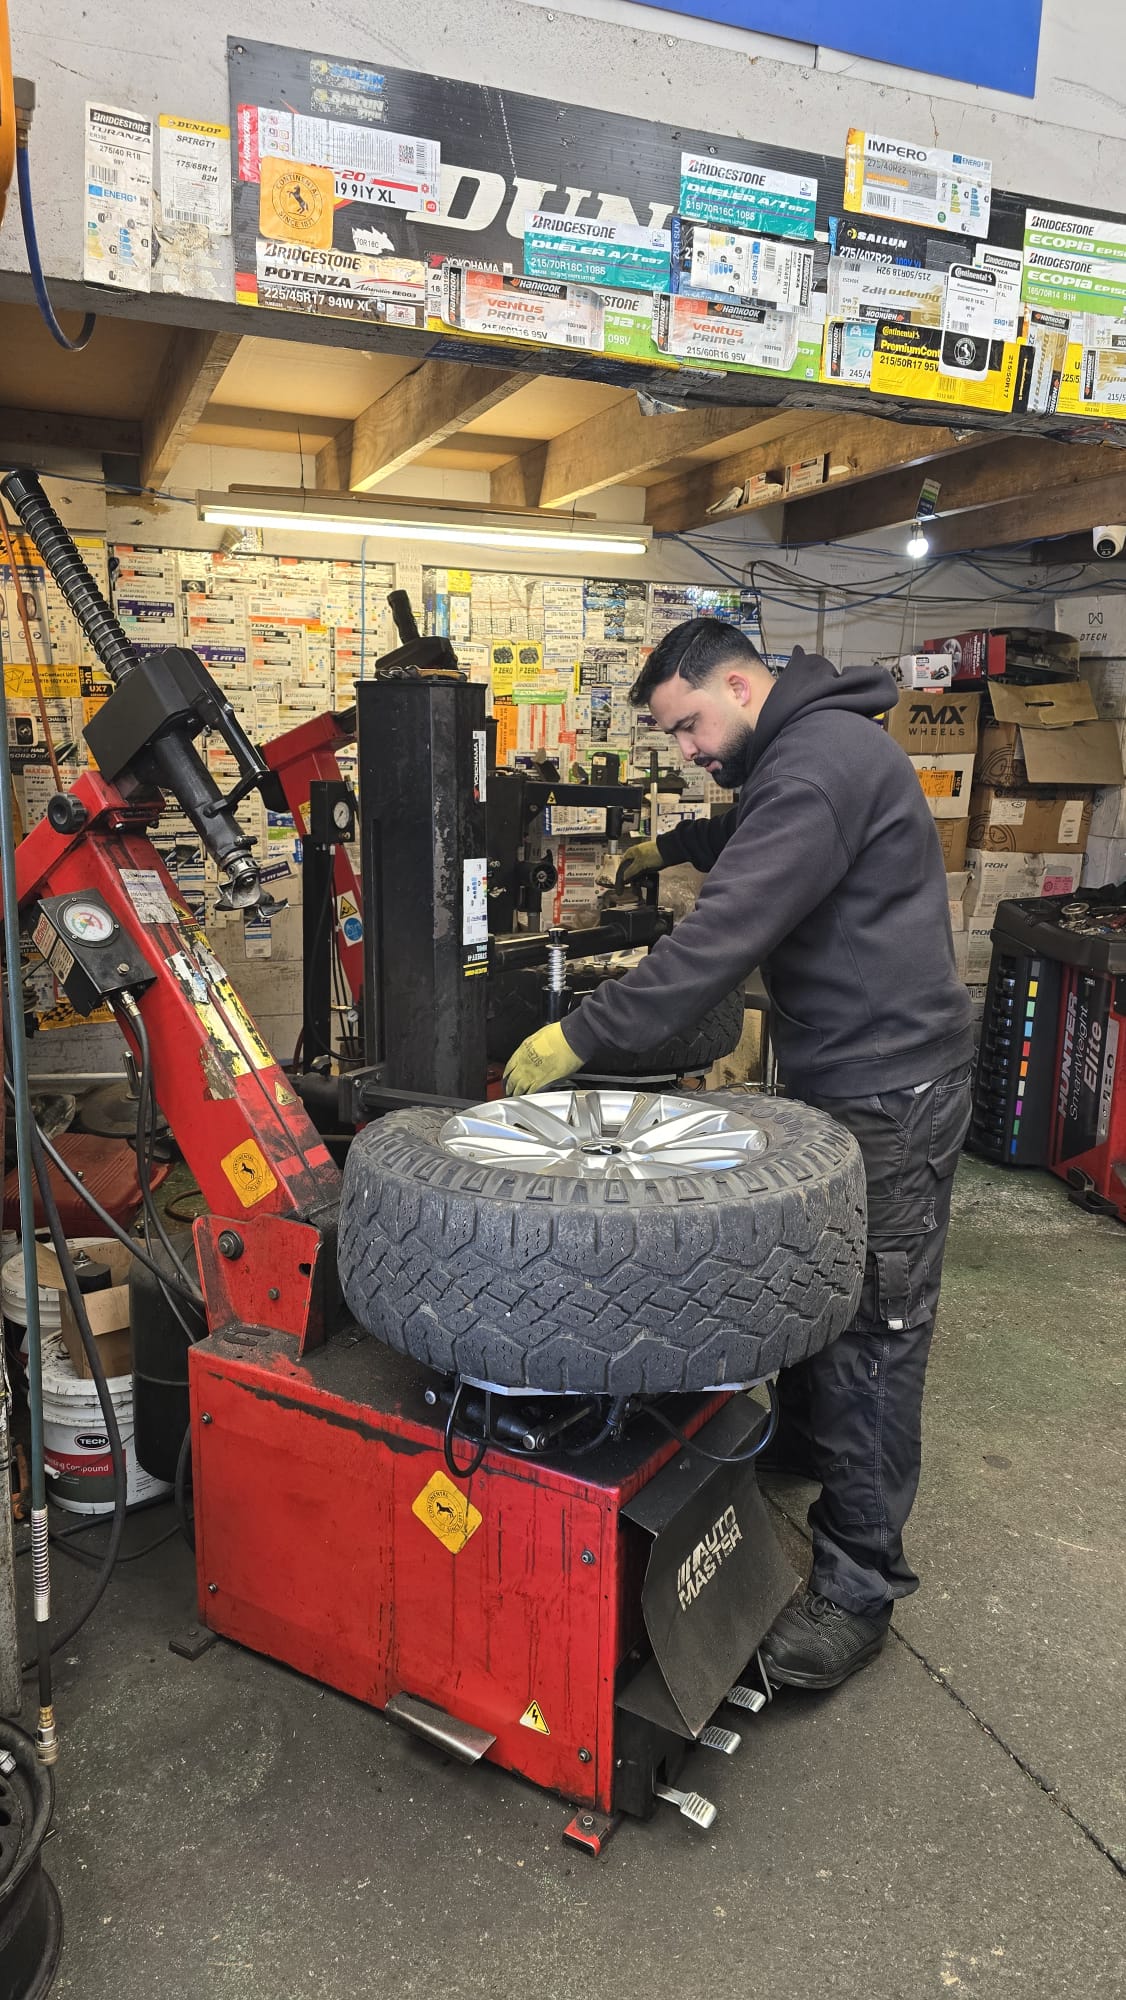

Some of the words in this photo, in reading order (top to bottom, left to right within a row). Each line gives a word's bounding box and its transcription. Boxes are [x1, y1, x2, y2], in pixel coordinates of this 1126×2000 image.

[93, 112, 149, 134] BRIDGESTONE
[177, 121, 222, 135] DUNLOP
[90, 125, 151, 144] TURANZA
[867, 139, 928, 162] IMPERO
[176, 160, 217, 173] 175/65R14
[688, 159, 767, 187] BRIDGESTONE
[201, 173, 218, 183] 82H
[276, 173, 319, 199] CONTINENTAL
[378, 188, 396, 204] XL
[687, 183, 756, 203] DUELER
[531, 215, 617, 240] BRIDGESTONE
[672, 219, 682, 236] SUV
[1030, 215, 1095, 236] BRIDGESTONE
[531, 239, 604, 258] DUELER
[857, 231, 908, 249] SAILUN
[264, 242, 362, 271] BRIDGESTONE
[839, 245, 893, 265] 275/40ZR22
[1028, 252, 1093, 274] BRIDGESTONE
[264, 266, 352, 289] POTENZA
[876, 265, 891, 275] 92H
[892, 269, 931, 281] 215/50R18
[954, 266, 989, 281] Continental
[800, 255, 813, 306] BRIDGESTONE
[264, 287, 325, 305] 225/45R17
[327, 295, 354, 310] 94W
[357, 301, 373, 313] XL
[862, 285, 886, 296] HP2
[887, 288, 941, 304] Dynapro
[531, 330, 548, 340] 95V
[881, 326, 915, 340] Continental
[686, 346, 730, 360] 215/60R16
[731, 353, 746, 362] 95V
[879, 355, 923, 370] 215/50R17
[1003, 355, 1014, 399] 215/50R17
[1079, 632, 1108, 642] DTECH
[908, 727, 966, 736] WHEELS
[984, 861, 1009, 869] ROH
[1057, 991, 1079, 1119] HUNTER
[1069, 1005, 1089, 1121] SmartWeight
[1083, 1021, 1103, 1094] Elite
[79, 1437, 106, 1446] TECH
[65, 1462, 109, 1473] Compound
[692, 1505, 737, 1573] AUTO
[678, 1522, 743, 1612] MASTER
